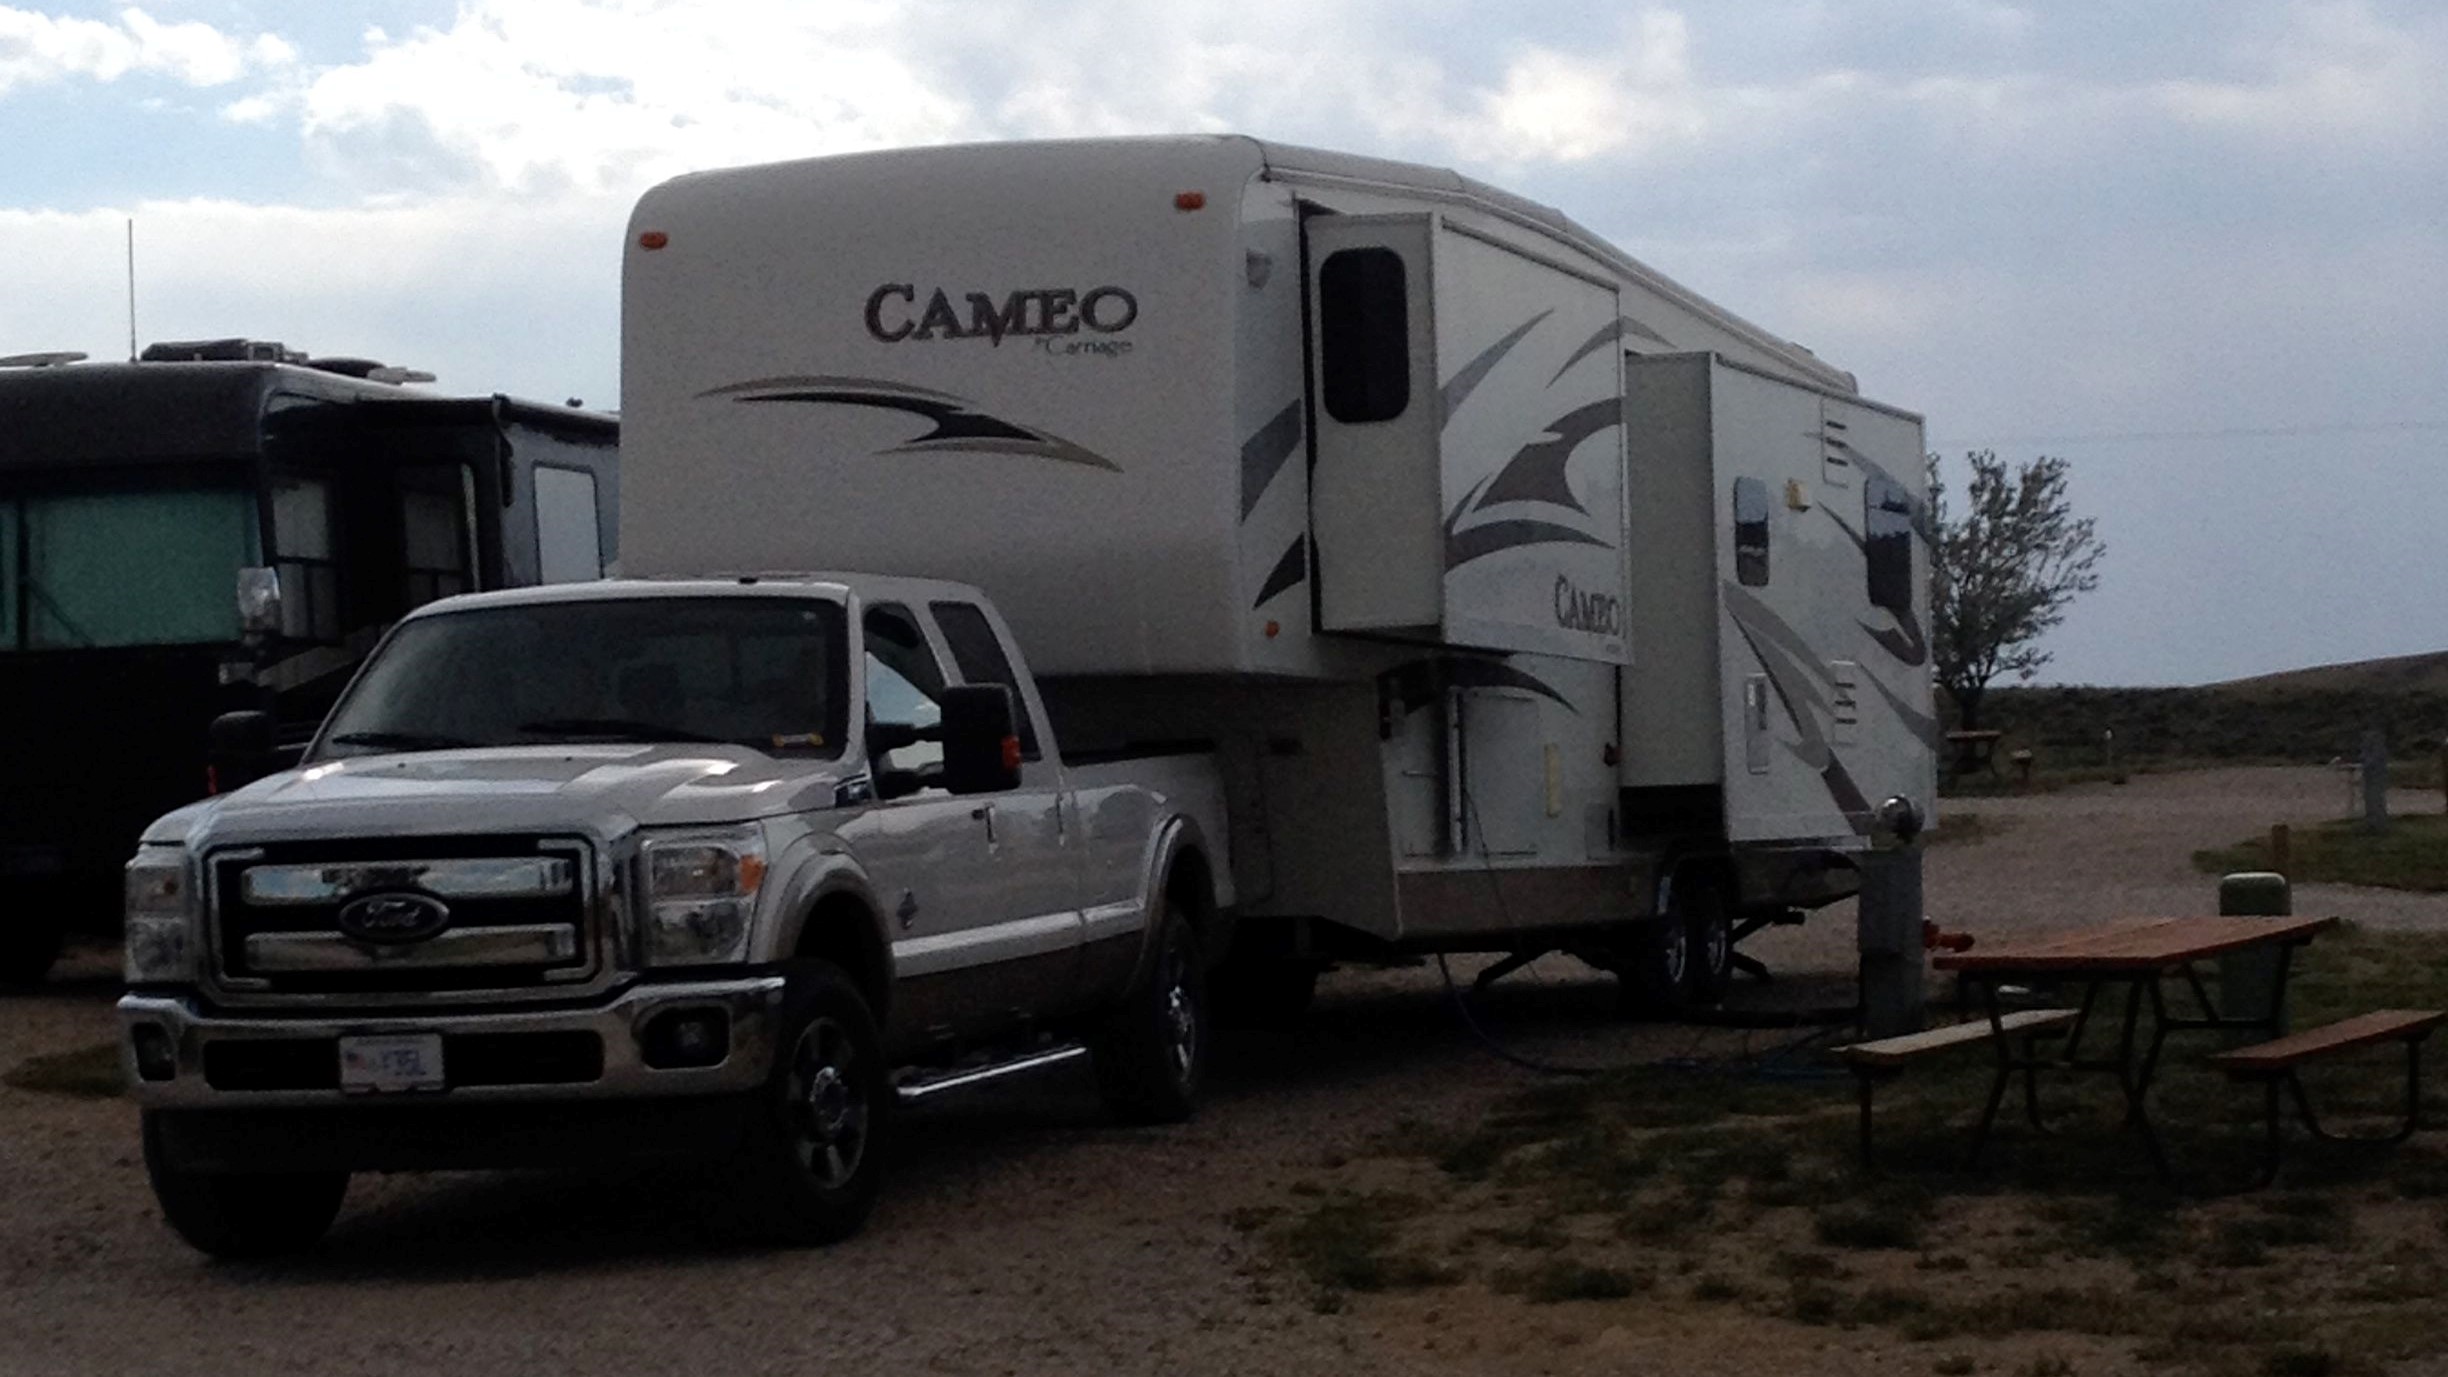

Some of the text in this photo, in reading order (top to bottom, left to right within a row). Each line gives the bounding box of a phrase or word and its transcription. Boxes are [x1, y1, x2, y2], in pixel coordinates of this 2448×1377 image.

[864, 283, 1138, 347] CAMEO
[1554, 574, 1620, 636] CAMEO
[361, 900, 422, 928] Ford
